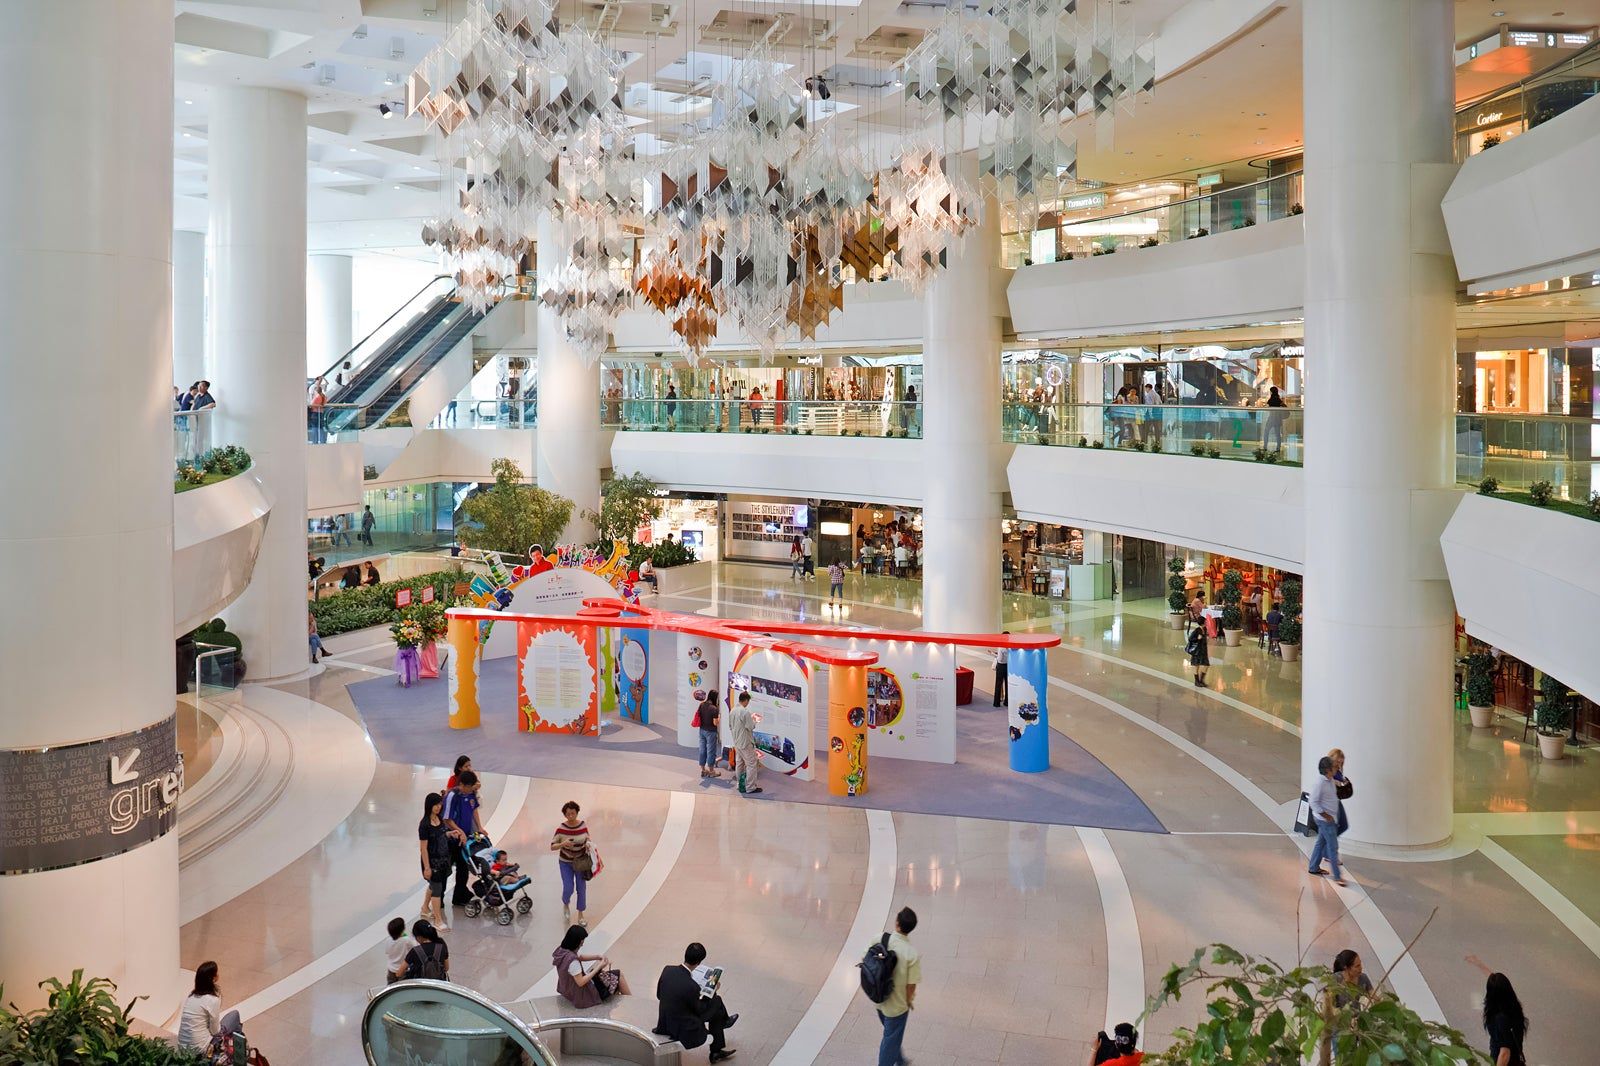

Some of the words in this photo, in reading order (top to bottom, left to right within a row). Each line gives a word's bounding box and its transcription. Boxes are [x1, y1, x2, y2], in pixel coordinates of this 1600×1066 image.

[1477, 112, 1503, 126] Cartier
[752, 504, 760, 514] THE
[762, 505, 794, 516] STYLEHUNTER
[70, 758, 93, 768] PIZZA
[22, 770, 62, 782] POULTRY
[26, 782, 53, 792] HERBS
[57, 776, 84, 788] SPICES
[37, 790, 57, 800] WINE
[60, 781, 108, 796] CHAMPAGNE
[40, 796, 68, 808] GREAT
[76, 791, 104, 802] CHOICE
[40, 806, 68, 817] PASTA
[72, 802, 88, 812] RICE
[18, 819, 37, 829] DELI
[41, 816, 64, 826] MEAT
[71, 808, 108, 822] POULTRY
[41, 824, 70, 835] CHEESE
[74, 818, 100, 830] HERBS
[41, 830, 81, 844] ORGANICS
[86, 826, 104, 836] WINE
